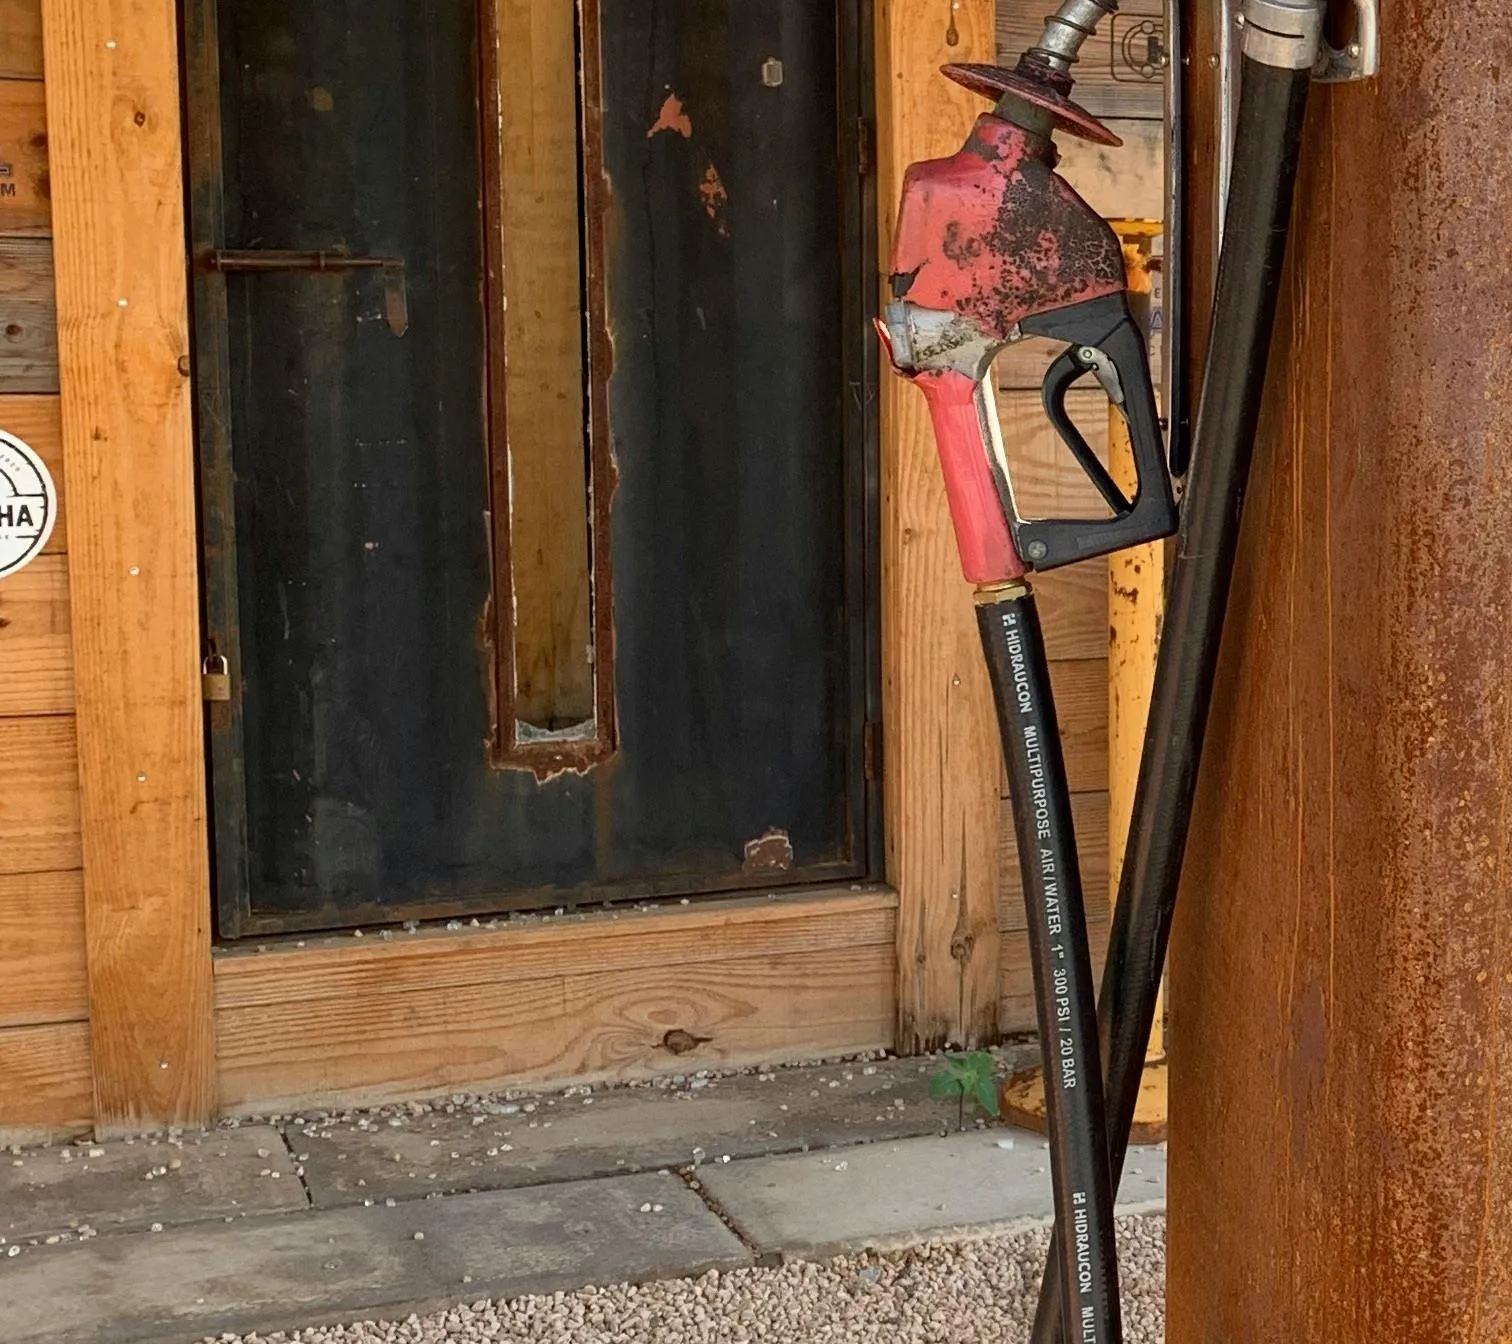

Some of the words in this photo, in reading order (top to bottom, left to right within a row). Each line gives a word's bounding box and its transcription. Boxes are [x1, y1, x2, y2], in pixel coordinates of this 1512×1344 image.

[1005, 629, 1033, 713] HIDRAUCON
[1023, 725, 1052, 841] MULTIPURPOSE
[1056, 996, 1071, 1022] PSI
[1062, 1057, 1077, 1089] BAR
[1074, 1208, 1093, 1294] HIDRAUCON
